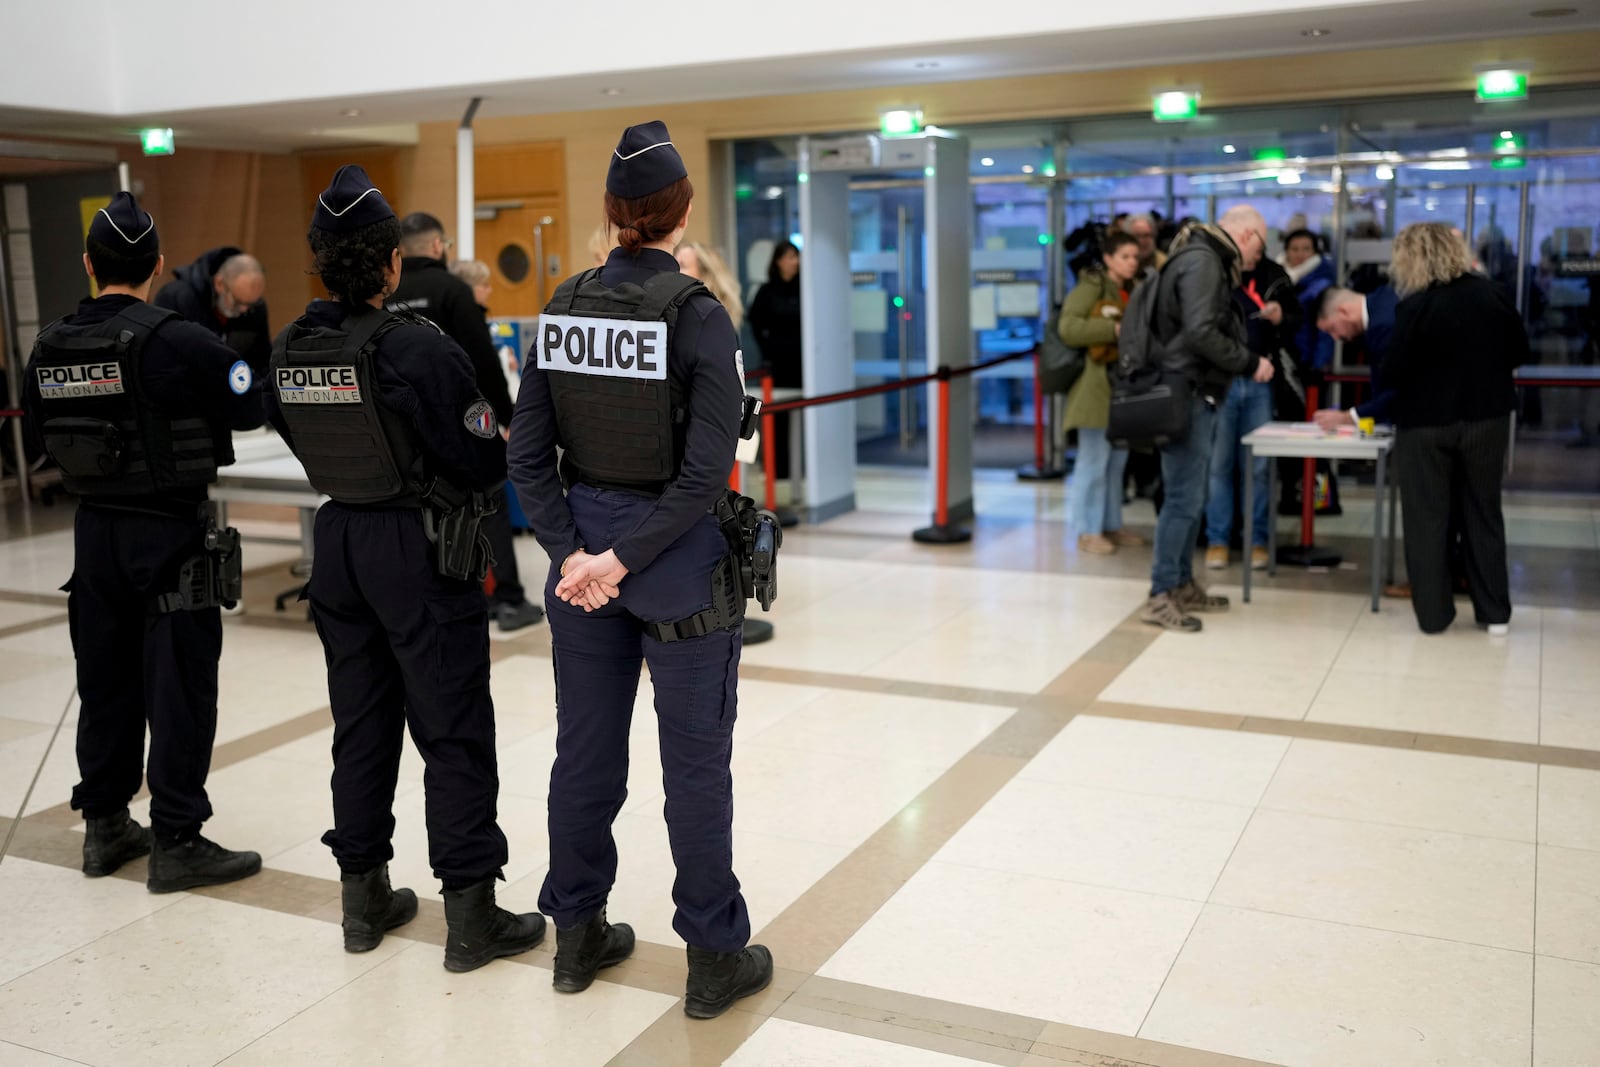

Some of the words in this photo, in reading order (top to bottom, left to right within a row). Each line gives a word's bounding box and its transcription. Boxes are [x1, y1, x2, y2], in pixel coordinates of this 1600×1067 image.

[544, 323, 658, 371] POLICE
[38, 364, 119, 384] POLICE
[278, 368, 355, 387] POLICE
[41, 383, 121, 397] NATIONALE
[281, 390, 360, 402] NATIONALE
